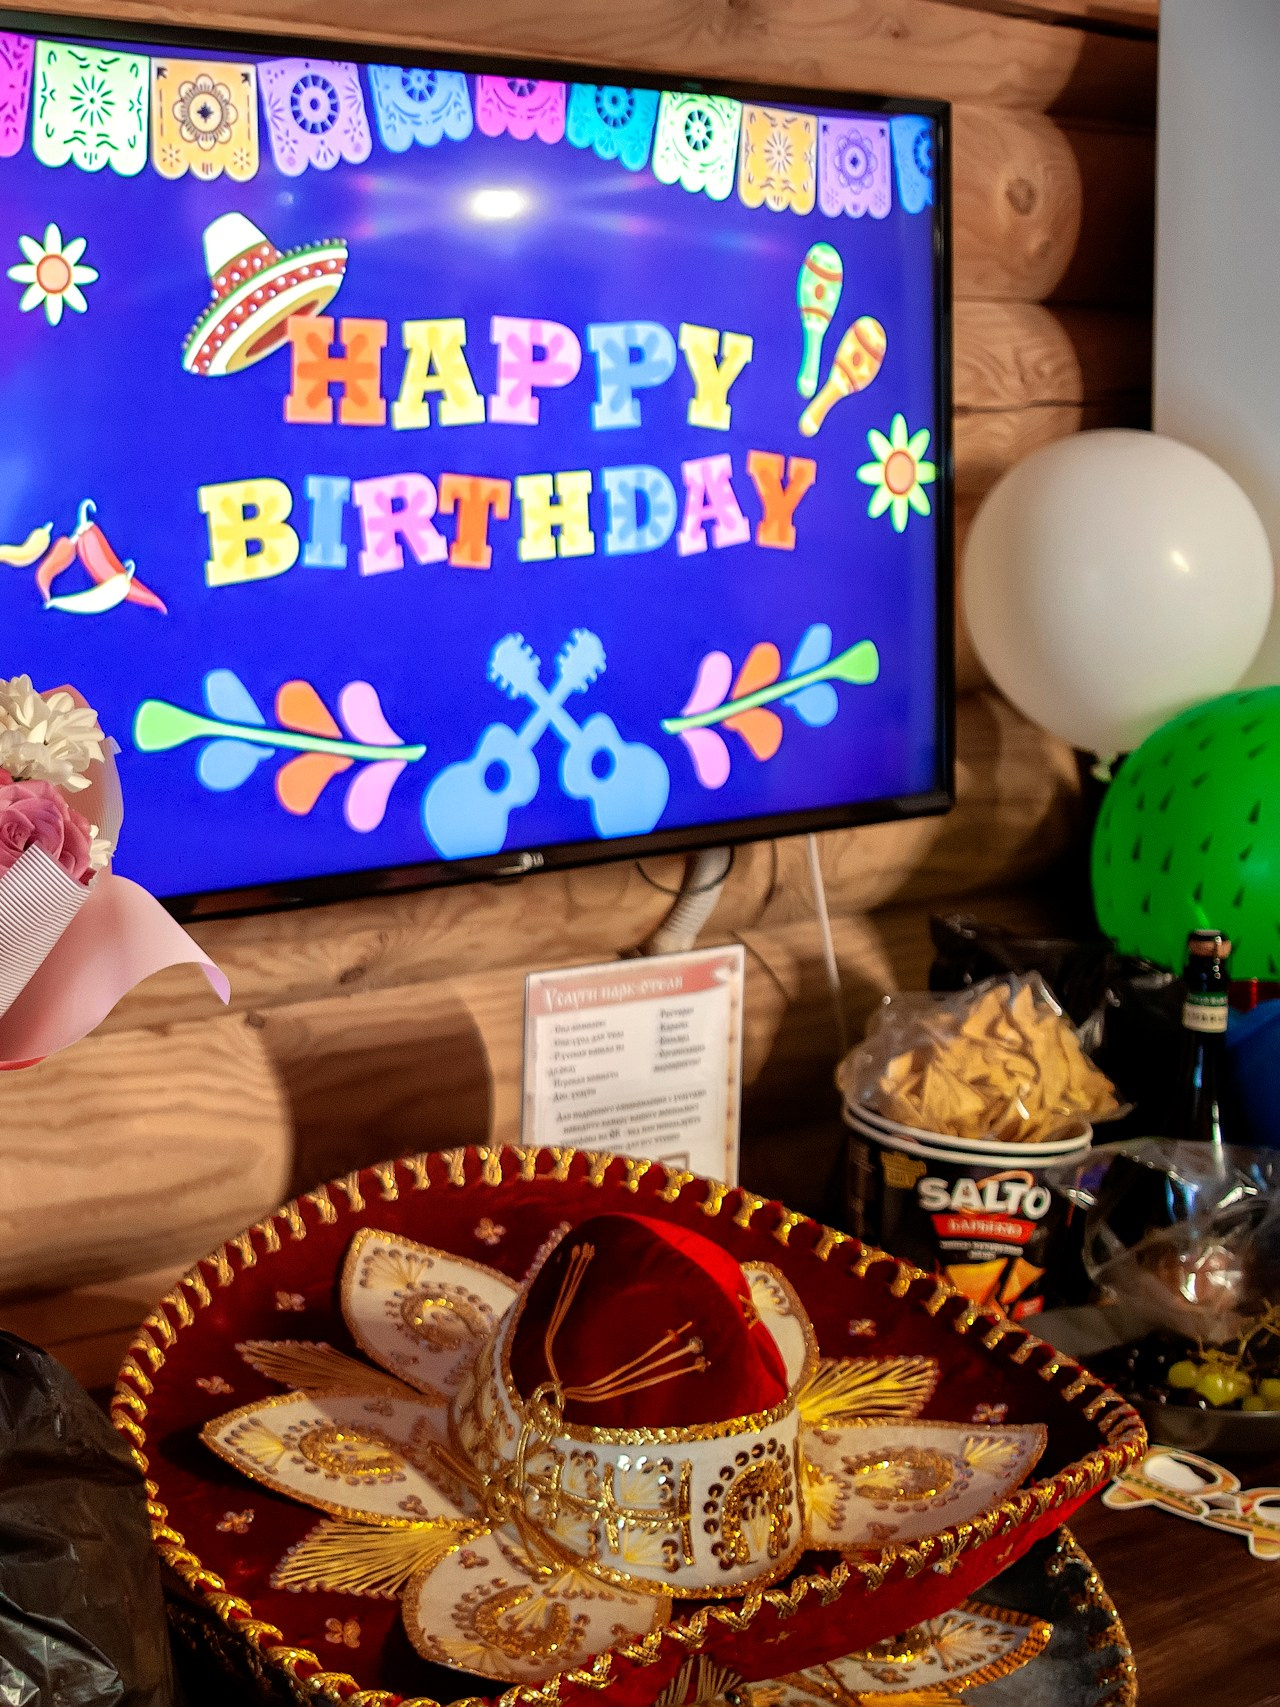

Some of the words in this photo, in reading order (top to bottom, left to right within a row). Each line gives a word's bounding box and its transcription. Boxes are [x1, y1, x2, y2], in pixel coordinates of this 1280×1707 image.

[283, 314, 753, 432] HAPPY
[198, 450, 817, 587] BIRTHDAY
[918, 1176, 1052, 1221] SALTO
